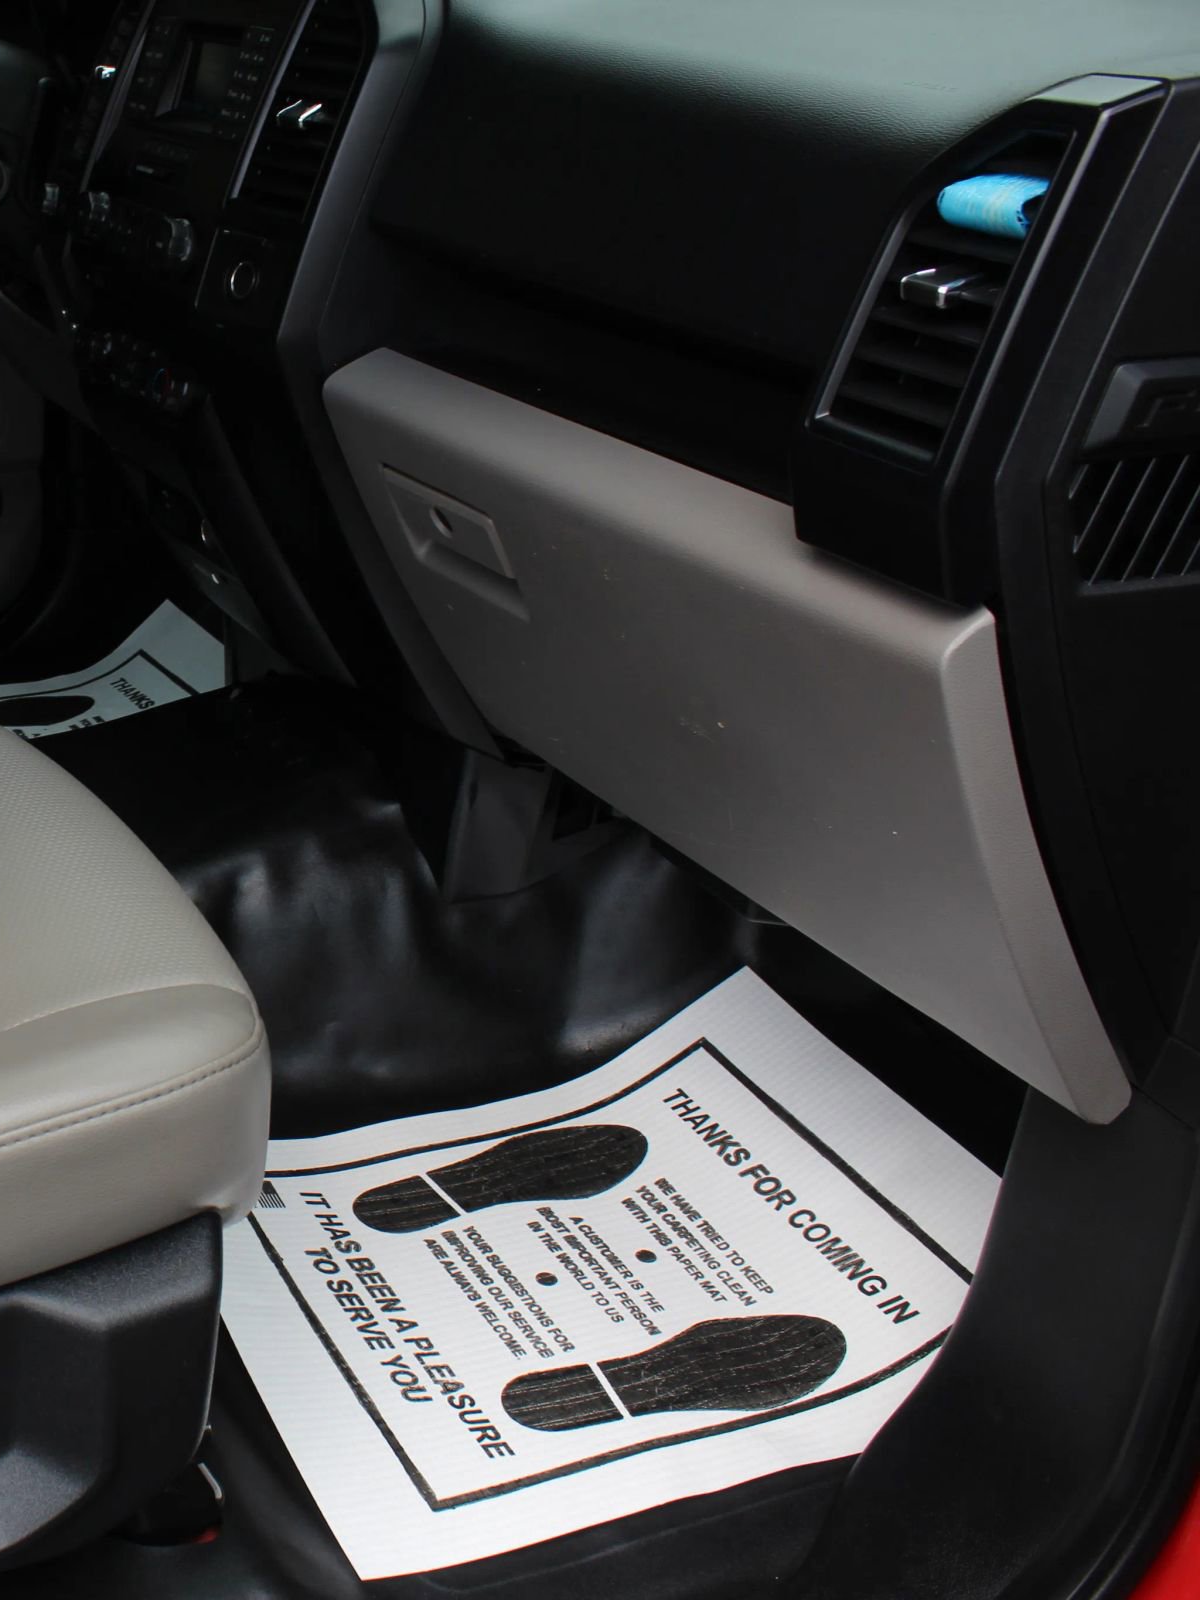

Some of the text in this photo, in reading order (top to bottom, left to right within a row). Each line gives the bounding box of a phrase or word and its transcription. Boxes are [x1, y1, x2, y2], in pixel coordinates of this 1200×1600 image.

[110, 677, 155, 711] THANKS
[621, 1197, 651, 1224] WITH
[666, 1246, 704, 1281] PAPER
[700, 1280, 728, 1303] MAT
[635, 1185, 757, 1306] YOUR CARPETING CLEAN
[662, 1088, 920, 1324] THANKS FOR COMING IN
[672, 1191, 701, 1222] HAVE
[696, 1219, 730, 1251] TRIED
[727, 1249, 745, 1267] TO
[740, 1266, 774, 1295] KEEP
[423, 1238, 448, 1260] ARE
[440, 1260, 482, 1302] ALWAYS
[441, 1230, 555, 1359] IMPROVING OUR SERVICE
[462, 1225, 575, 1352] YOUR SUGGESTIONS FOR
[526, 1221, 624, 1324] IN THE WORLD TO US
[563, 1234, 622, 1290] IMPORTANT
[614, 1291, 662, 1336] PERSON
[568, 1216, 665, 1313] A CUSTOMER IS THE
[299, 1192, 515, 1459] IT HAS BEEN A PLEASURE
[304, 1247, 433, 1403] TO SERVE YOU
